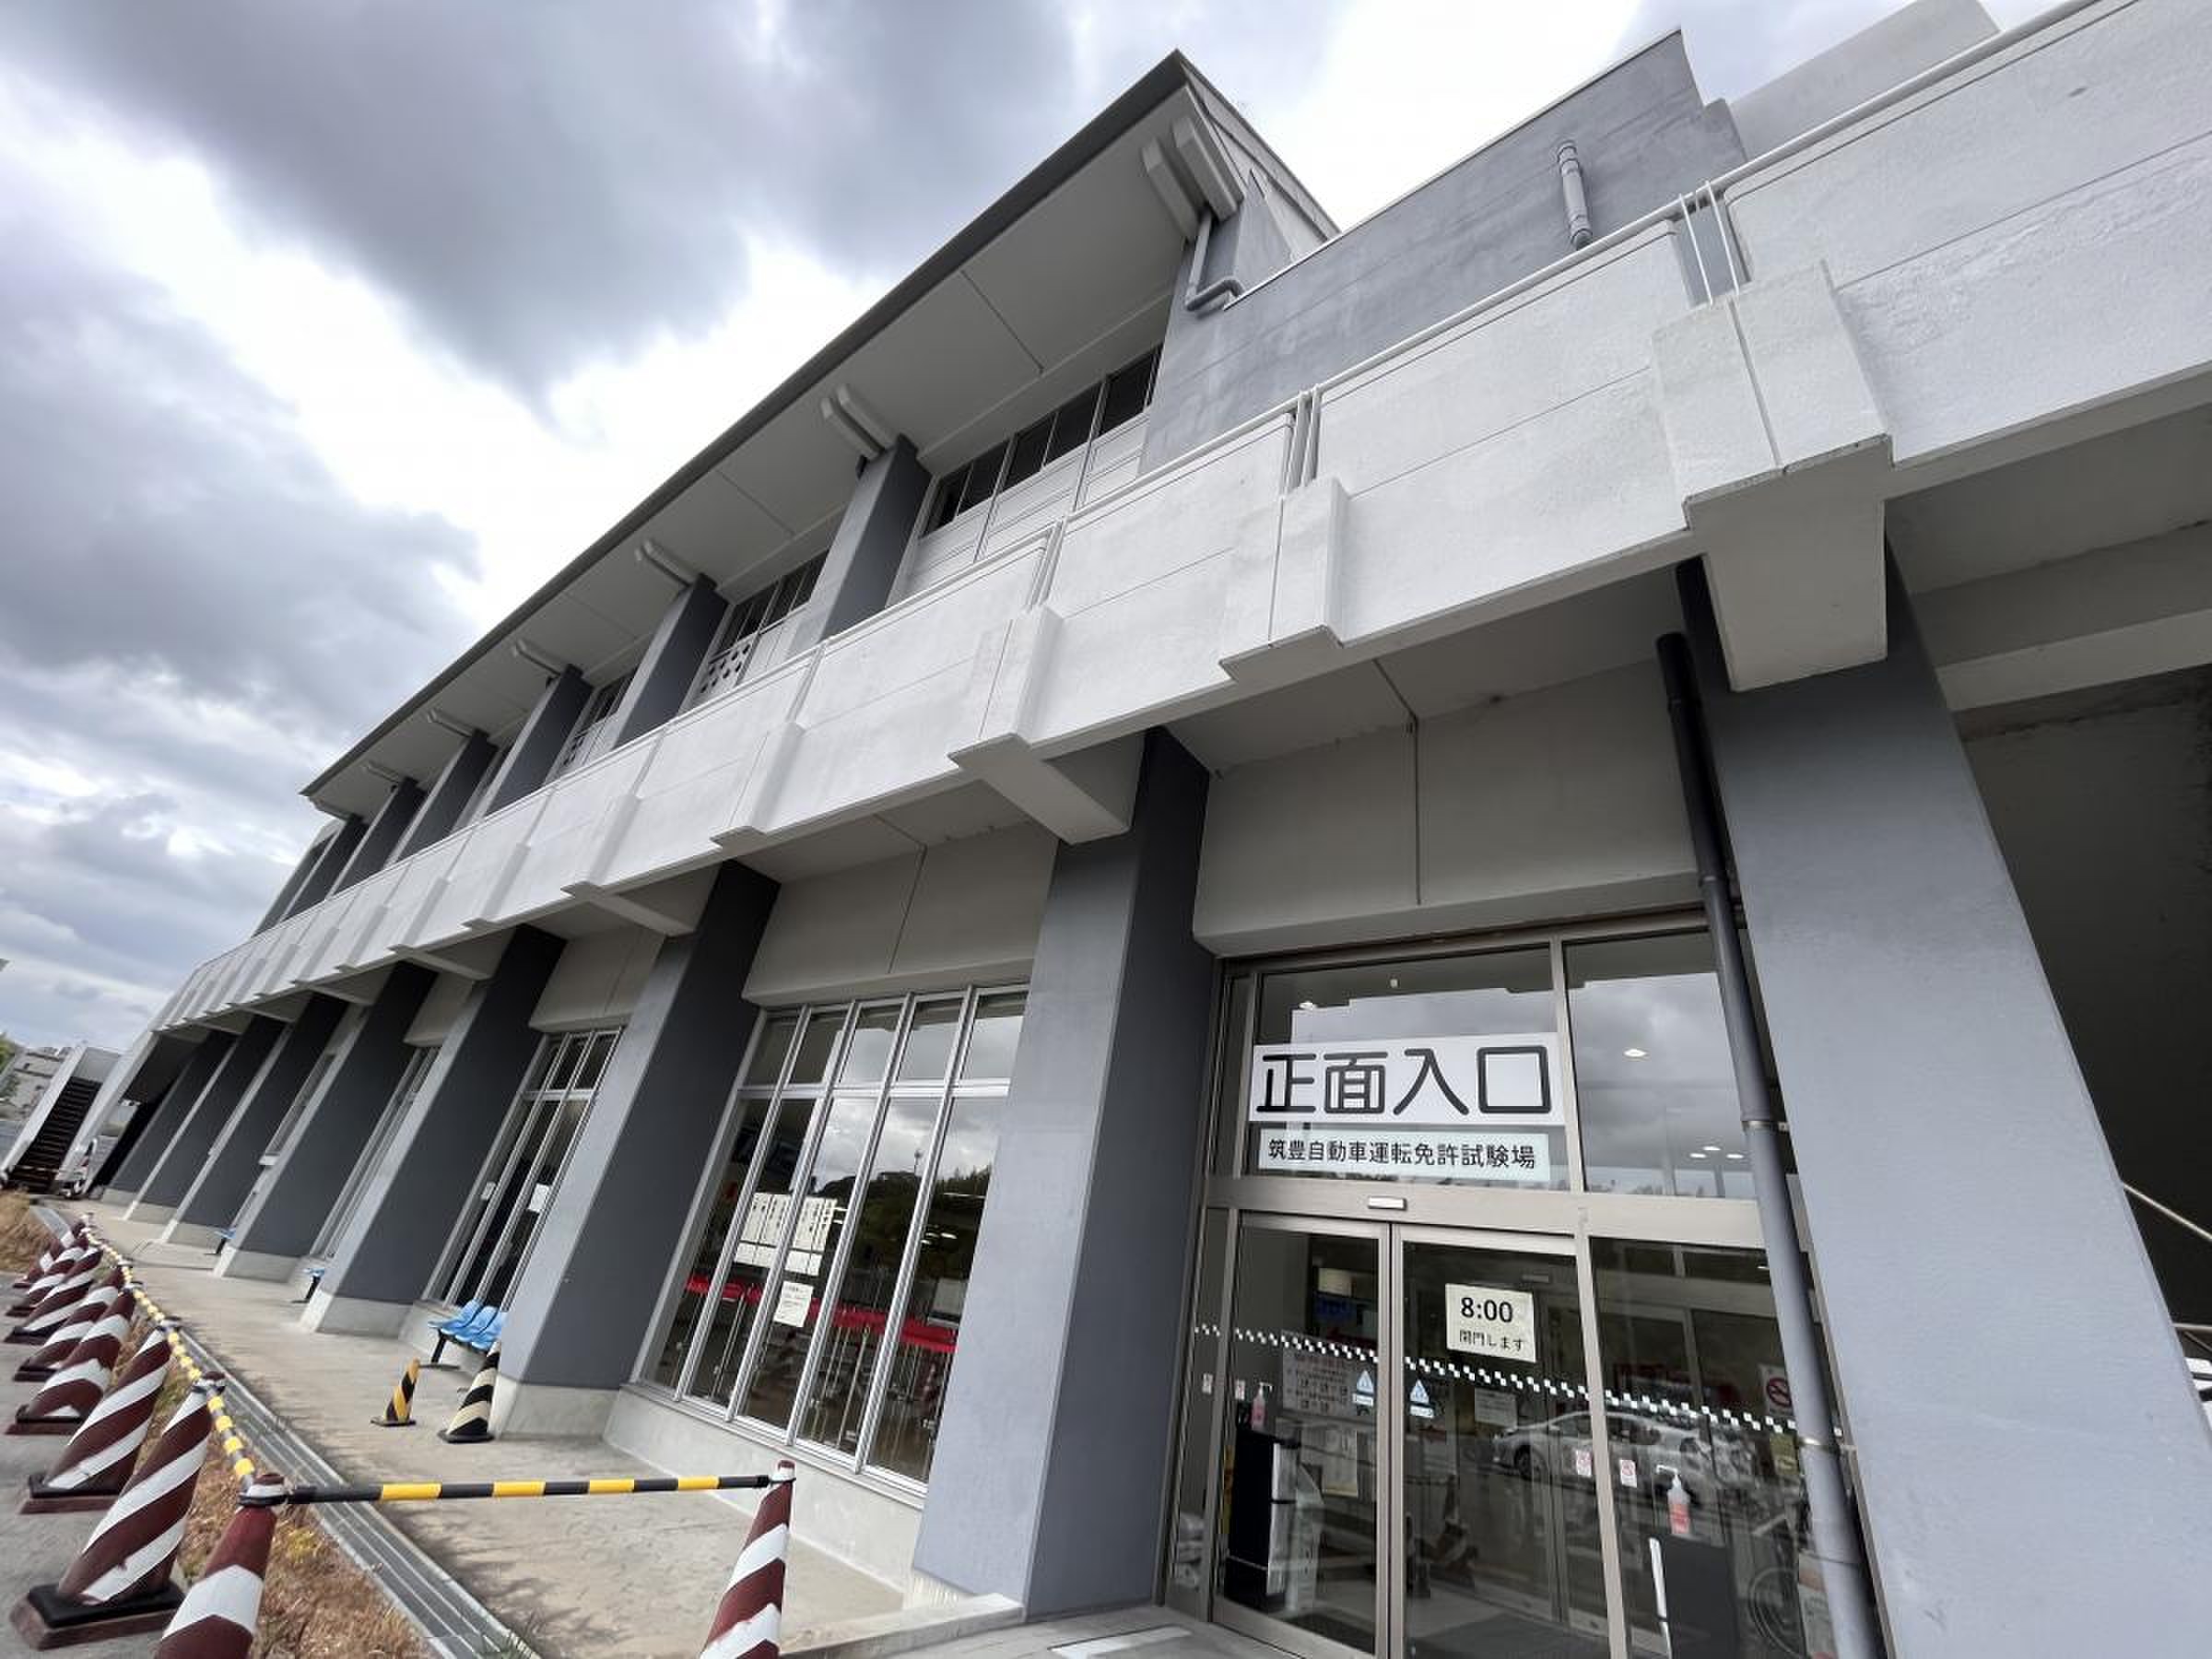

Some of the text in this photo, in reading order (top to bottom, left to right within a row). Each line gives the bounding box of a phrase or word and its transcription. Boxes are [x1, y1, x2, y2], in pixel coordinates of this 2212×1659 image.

[1255, 1045, 1552, 1116] 正面入口
[1268, 1138, 1535, 1170] 筑豊自動車運転免許試験場
[1461, 1297, 1513, 1323] 8:00
